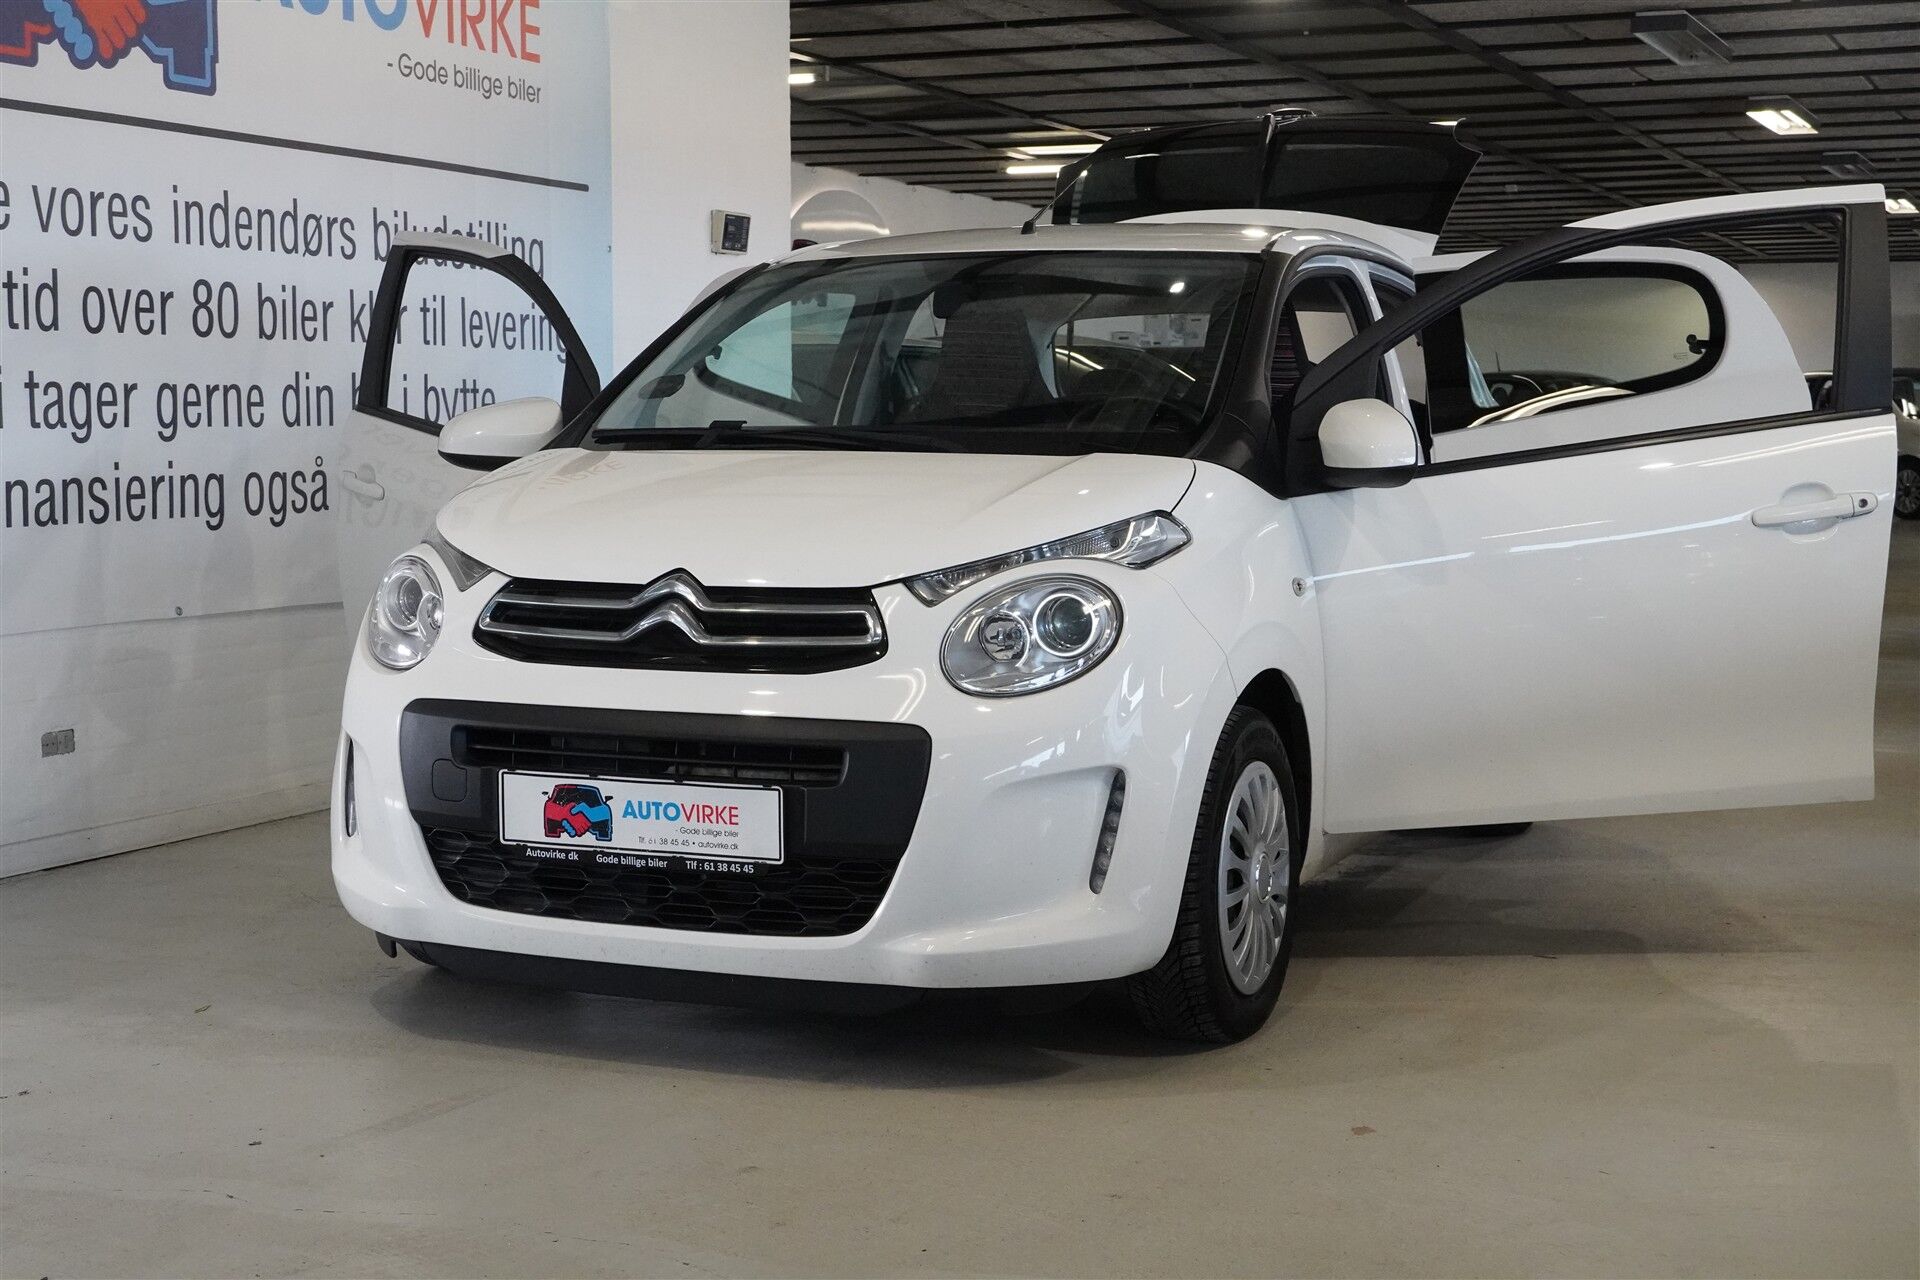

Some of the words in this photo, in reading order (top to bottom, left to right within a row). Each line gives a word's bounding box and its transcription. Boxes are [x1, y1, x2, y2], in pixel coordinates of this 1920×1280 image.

[256, 0, 541, 63] VIRKE
[398, 53, 448, 84] Gode
[453, 64, 503, 100] billige
[507, 76, 541, 103] biler
[32, 185, 153, 243] vores
[172, 185, 357, 260] indendørs
[2, 267, 59, 332] tid
[82, 286, 174, 335] over
[192, 279, 239, 339] 80
[257, 282, 334, 342] biler
[349, 289, 408, 344] klr
[419, 294, 446, 346] til
[24, 370, 138, 443] tager
[156, 382, 264, 442] gerne
[282, 371, 334, 427] din
[424, 373, 496, 423] bytte
[5, 460, 224, 531] nansiering
[244, 456, 329, 527] også
[622, 800, 739, 825] AUTOVIRKE
[680, 827, 700, 835] Gode
[702, 828, 722, 838] billige
[724, 829, 739, 838] biler
[526, 848, 566, 859] Autovirke
[568, 851, 579, 860] dk
[596, 854, 618, 864] Gode
[620, 856, 646, 868] billige
[648, 857, 667, 868] biler
[686, 860, 697, 870] Tlf
[704, 861, 714, 871] 61
[717, 863, 728, 872] 38
[729, 864, 741, 873] 45
[742, 864, 754, 874] 45
[670, 838, 679, 846] 45
[681, 839, 690, 847] 45
[698, 841, 739, 850] autovirke.dk
